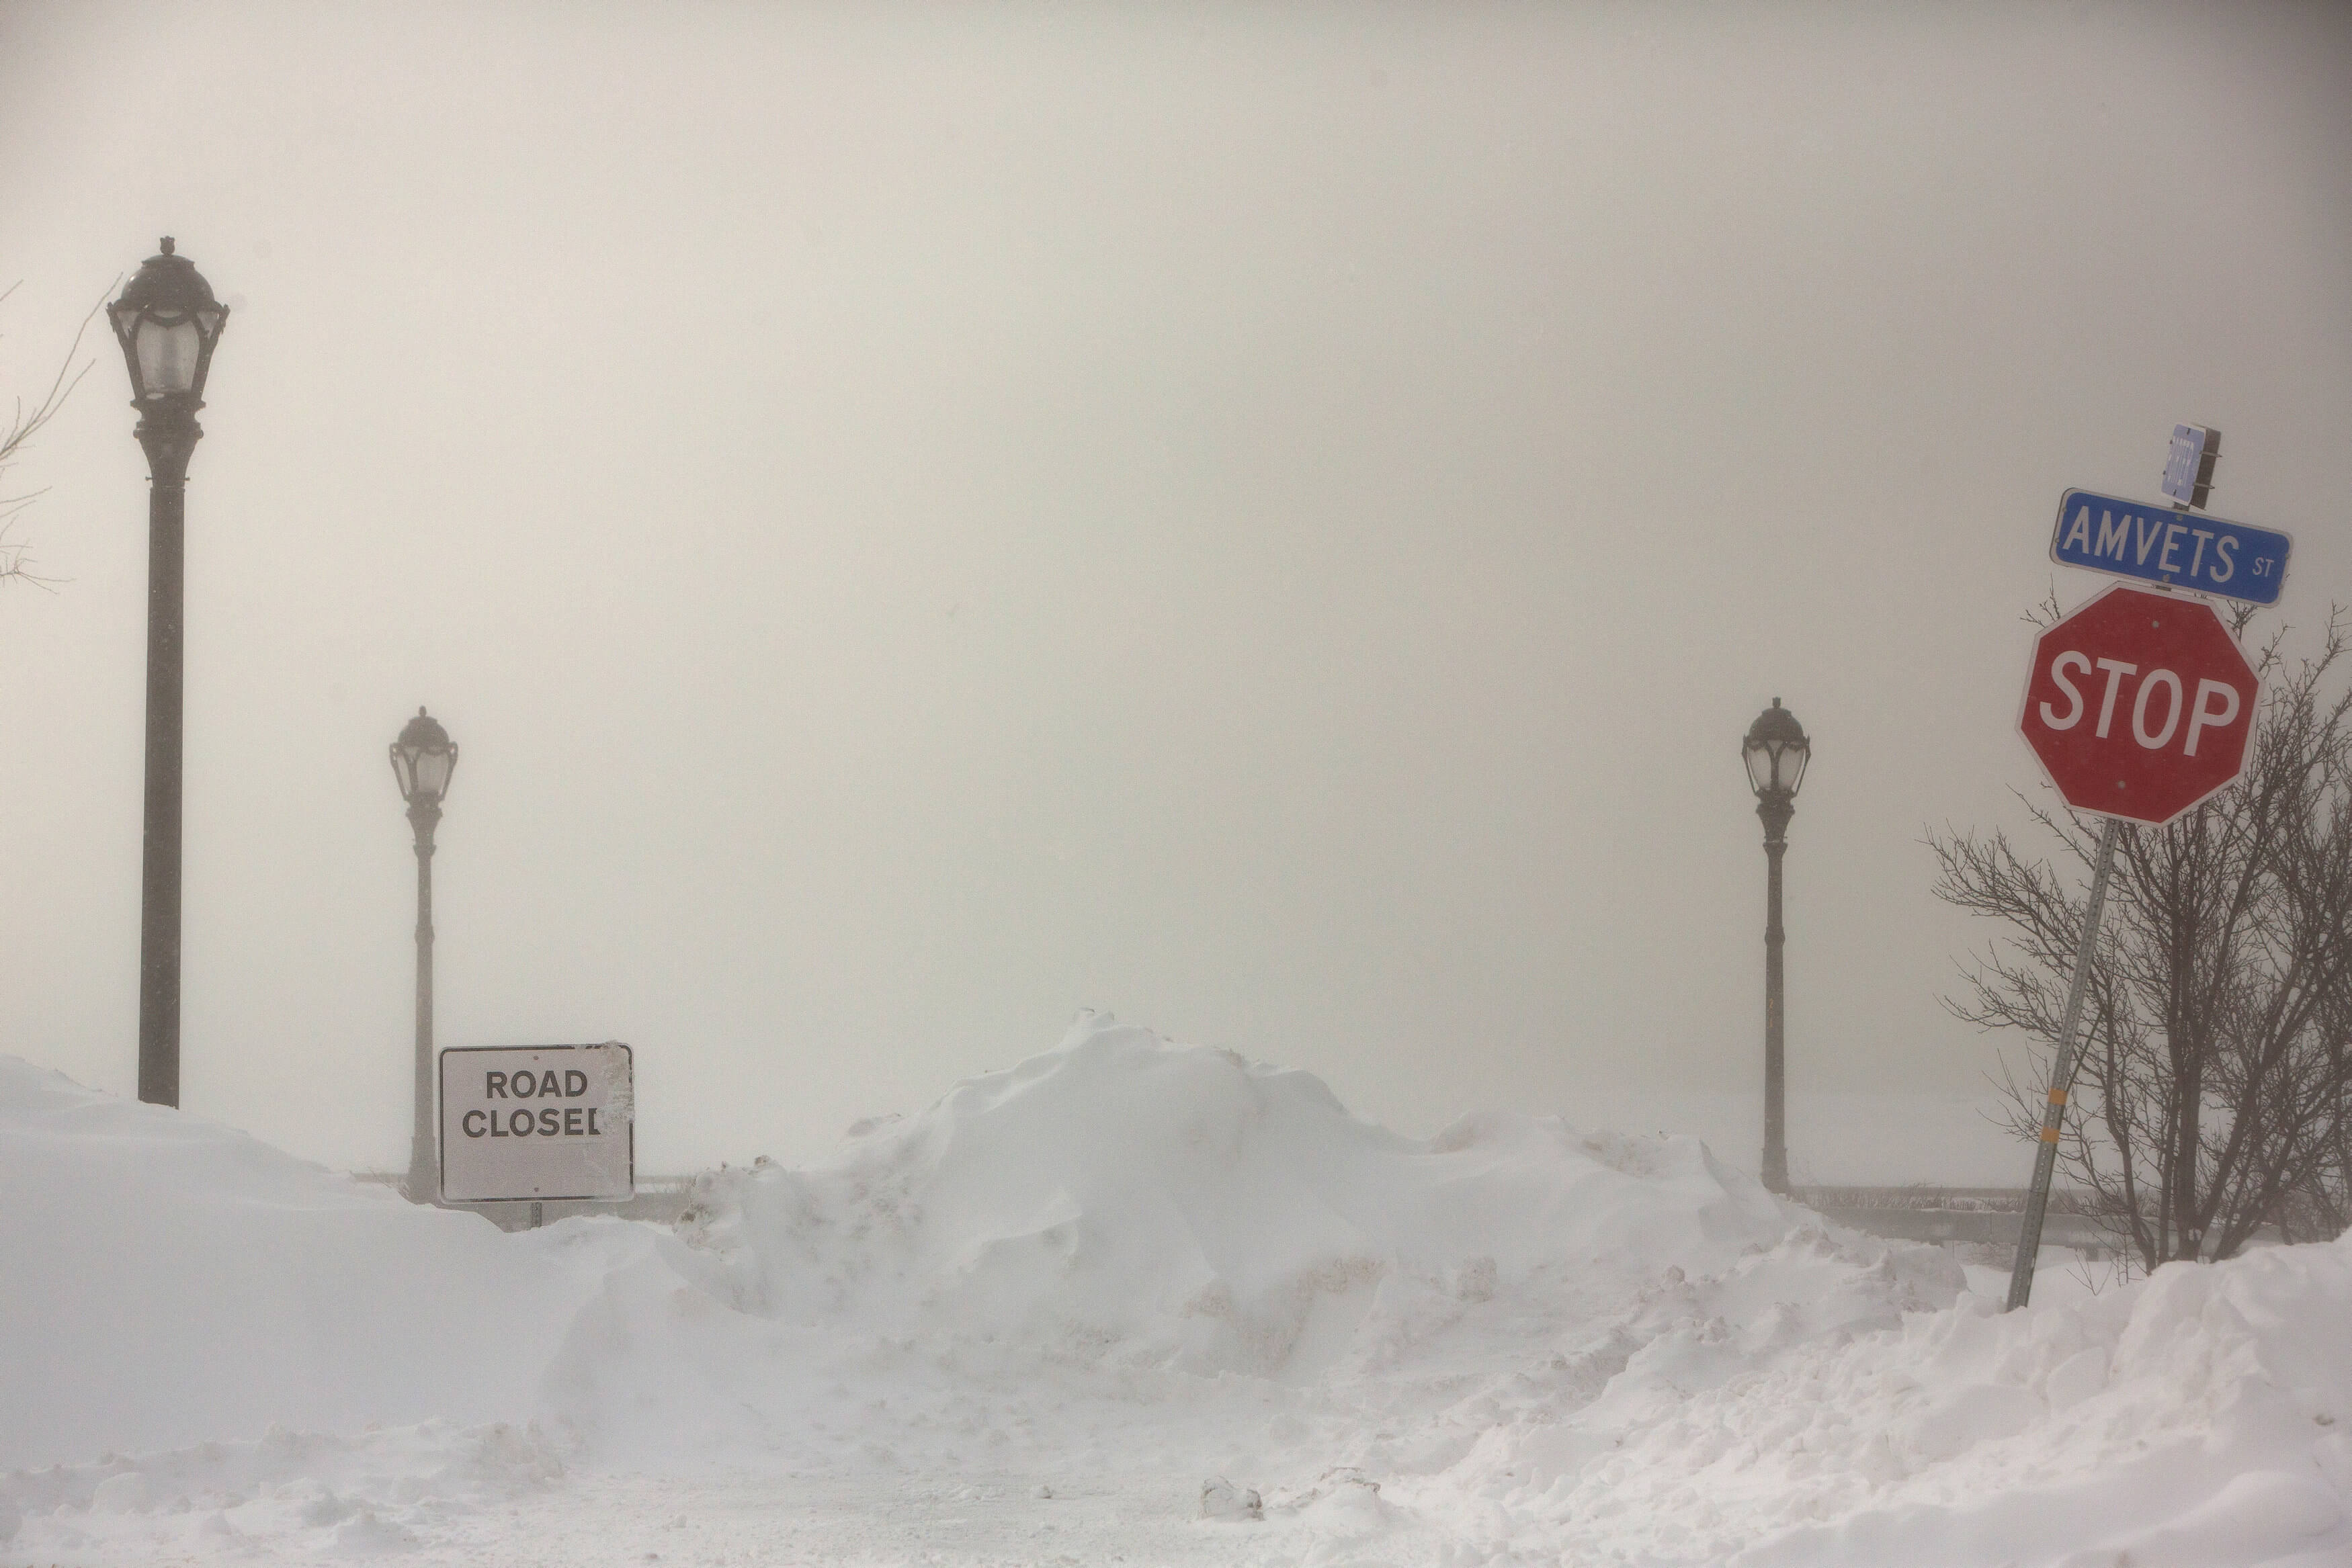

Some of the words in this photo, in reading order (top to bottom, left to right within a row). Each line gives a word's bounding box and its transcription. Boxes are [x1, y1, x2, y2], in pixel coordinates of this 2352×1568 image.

[2062, 505, 2239, 582] AMVETS
[2252, 557, 2275, 578] ST
[2039, 650, 2240, 756] STOP
[486, 1070, 588, 1098] ROAD
